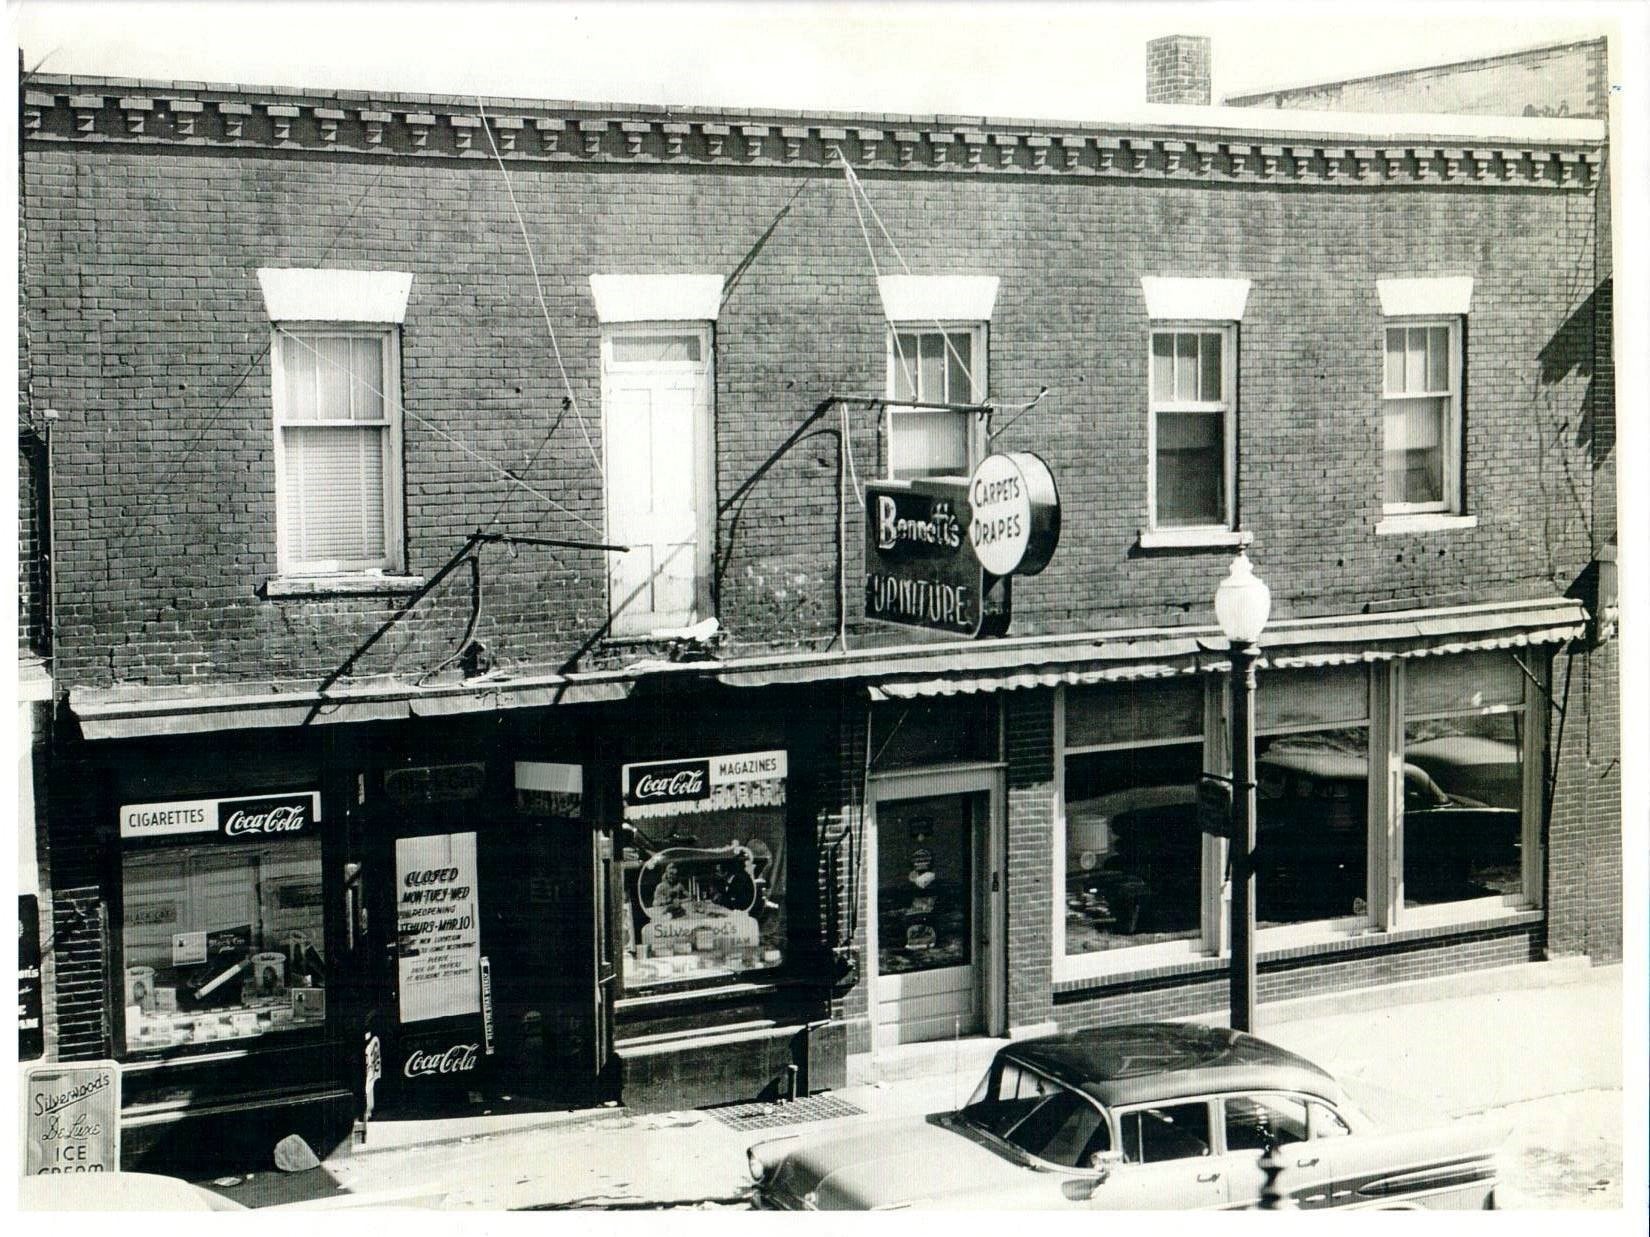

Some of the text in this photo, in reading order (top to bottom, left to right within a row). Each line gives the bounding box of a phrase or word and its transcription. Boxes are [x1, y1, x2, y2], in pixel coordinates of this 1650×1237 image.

[974, 476, 1020, 507] CARPETS
[878, 496, 960, 549] Bennett's
[974, 514, 1021, 547] DRAPES
[719, 758, 777, 776] MAGAZINES
[129, 808, 204, 828] CIGARETTES
[405, 868, 459, 887] CLOSED
[654, 922, 737, 939] Silverod's
[34, 1072, 110, 1117] Silverwood's
[56, 1145, 88, 1162] ICE
